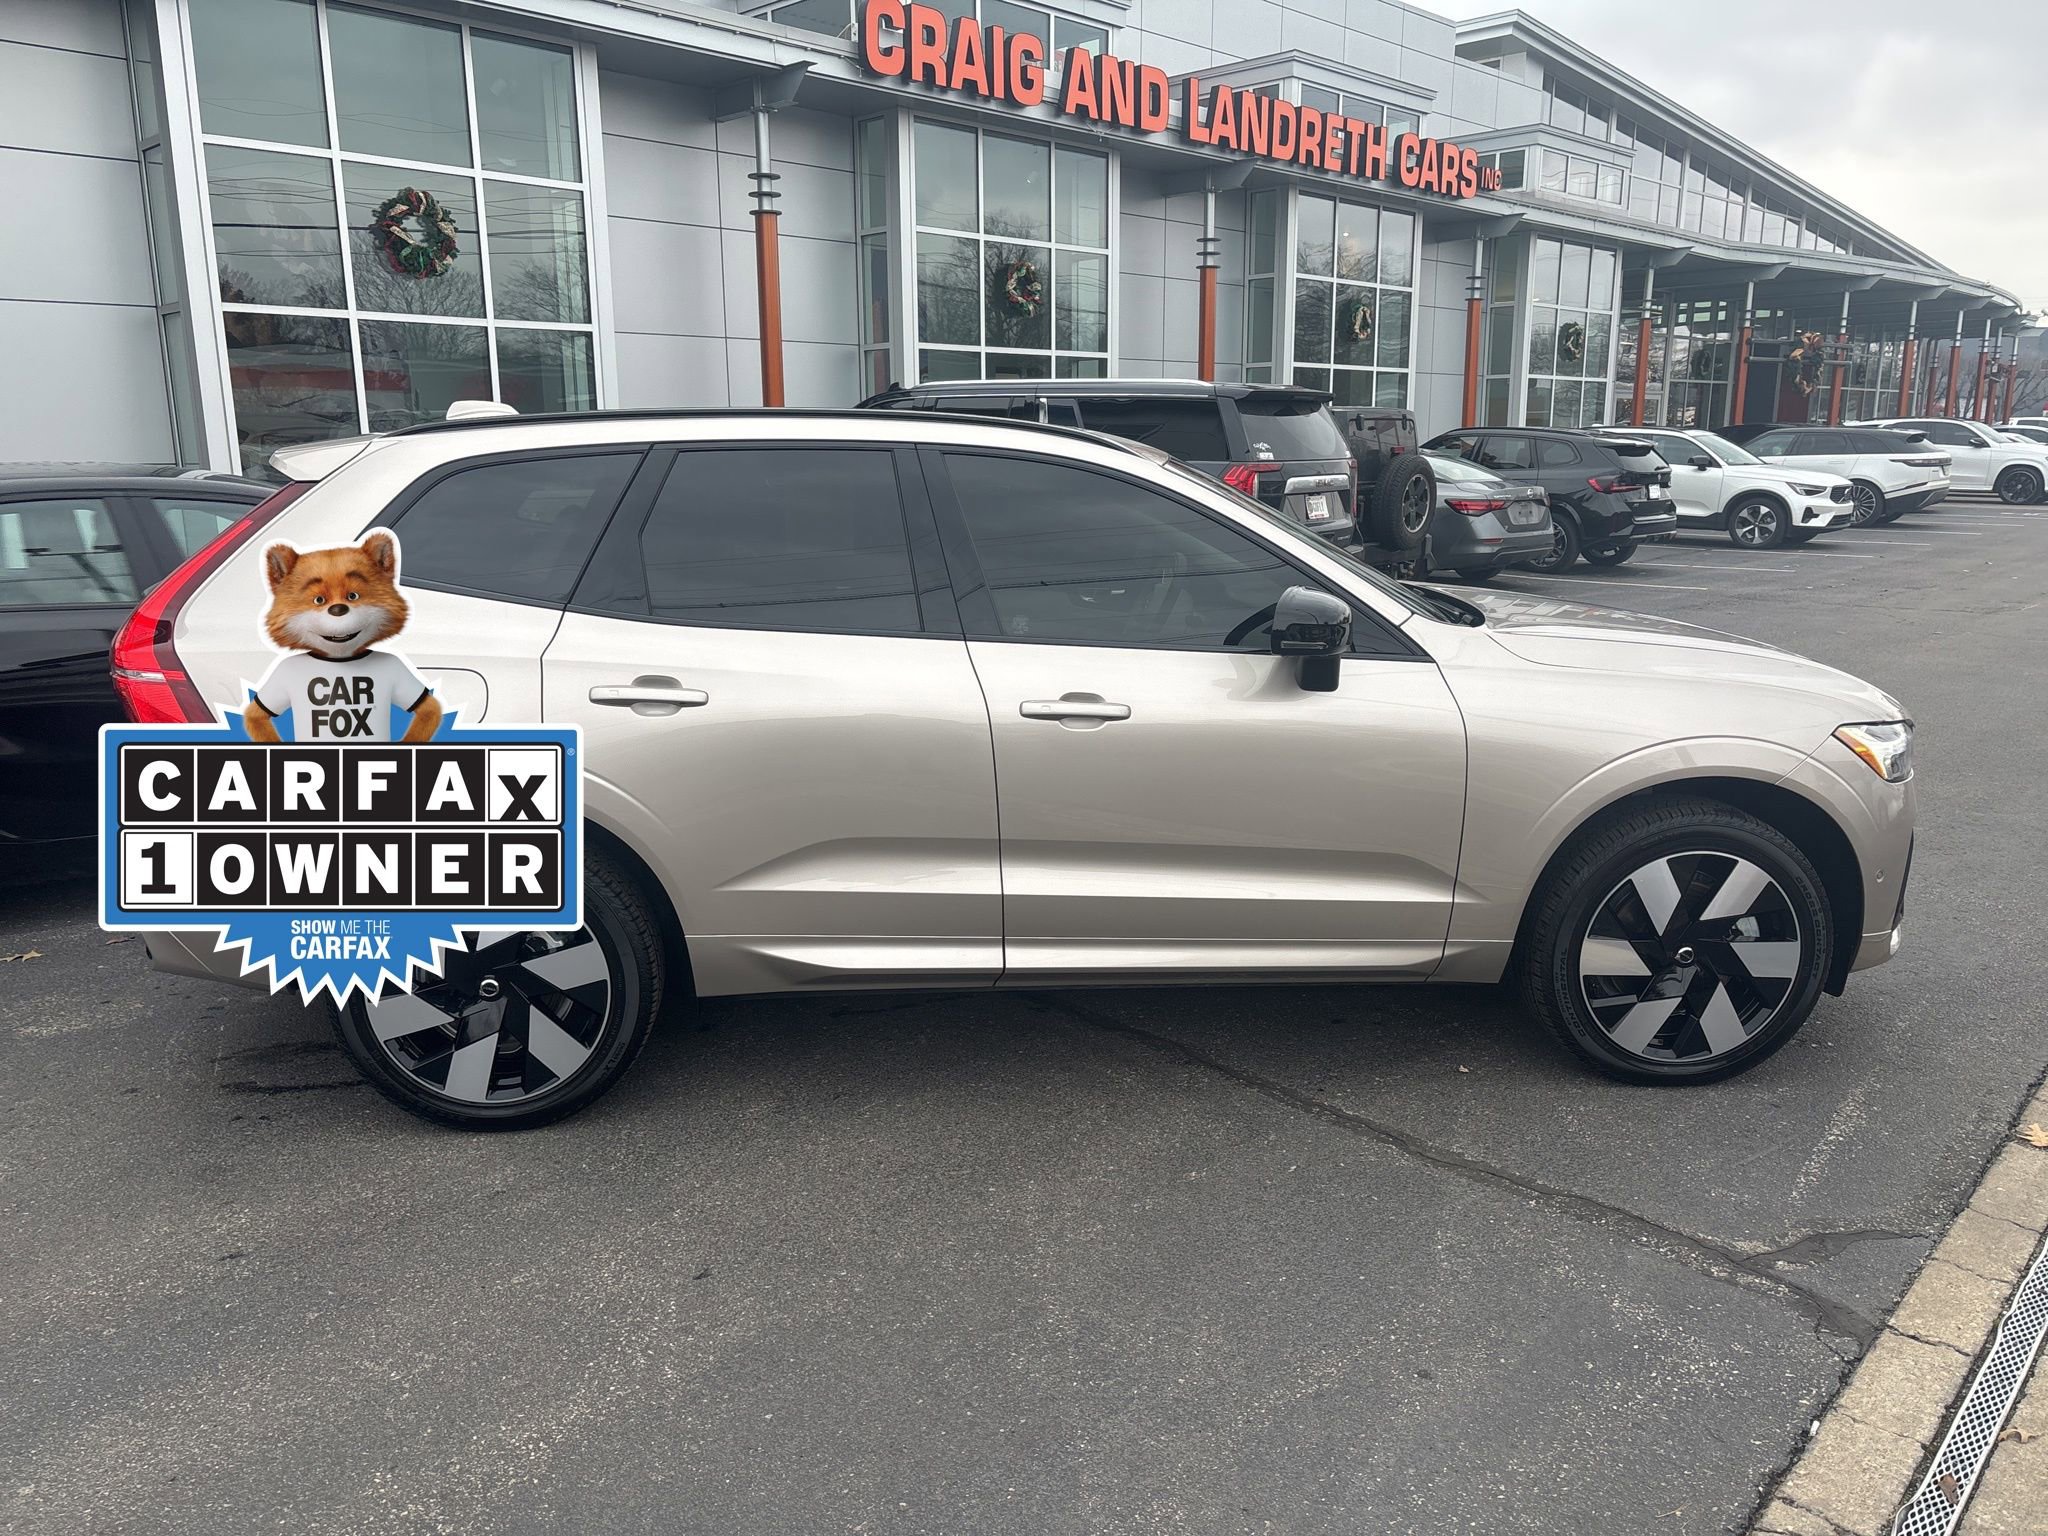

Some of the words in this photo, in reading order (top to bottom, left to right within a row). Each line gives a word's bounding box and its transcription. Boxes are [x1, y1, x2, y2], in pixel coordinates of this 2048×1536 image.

[863, 0, 1044, 106] CRAIG
[1063, 47, 1169, 132] AND
[1185, 77, 1388, 181] LANDRETH
[1397, 131, 1479, 199] CARS
[1481, 166, 1503, 191] INC
